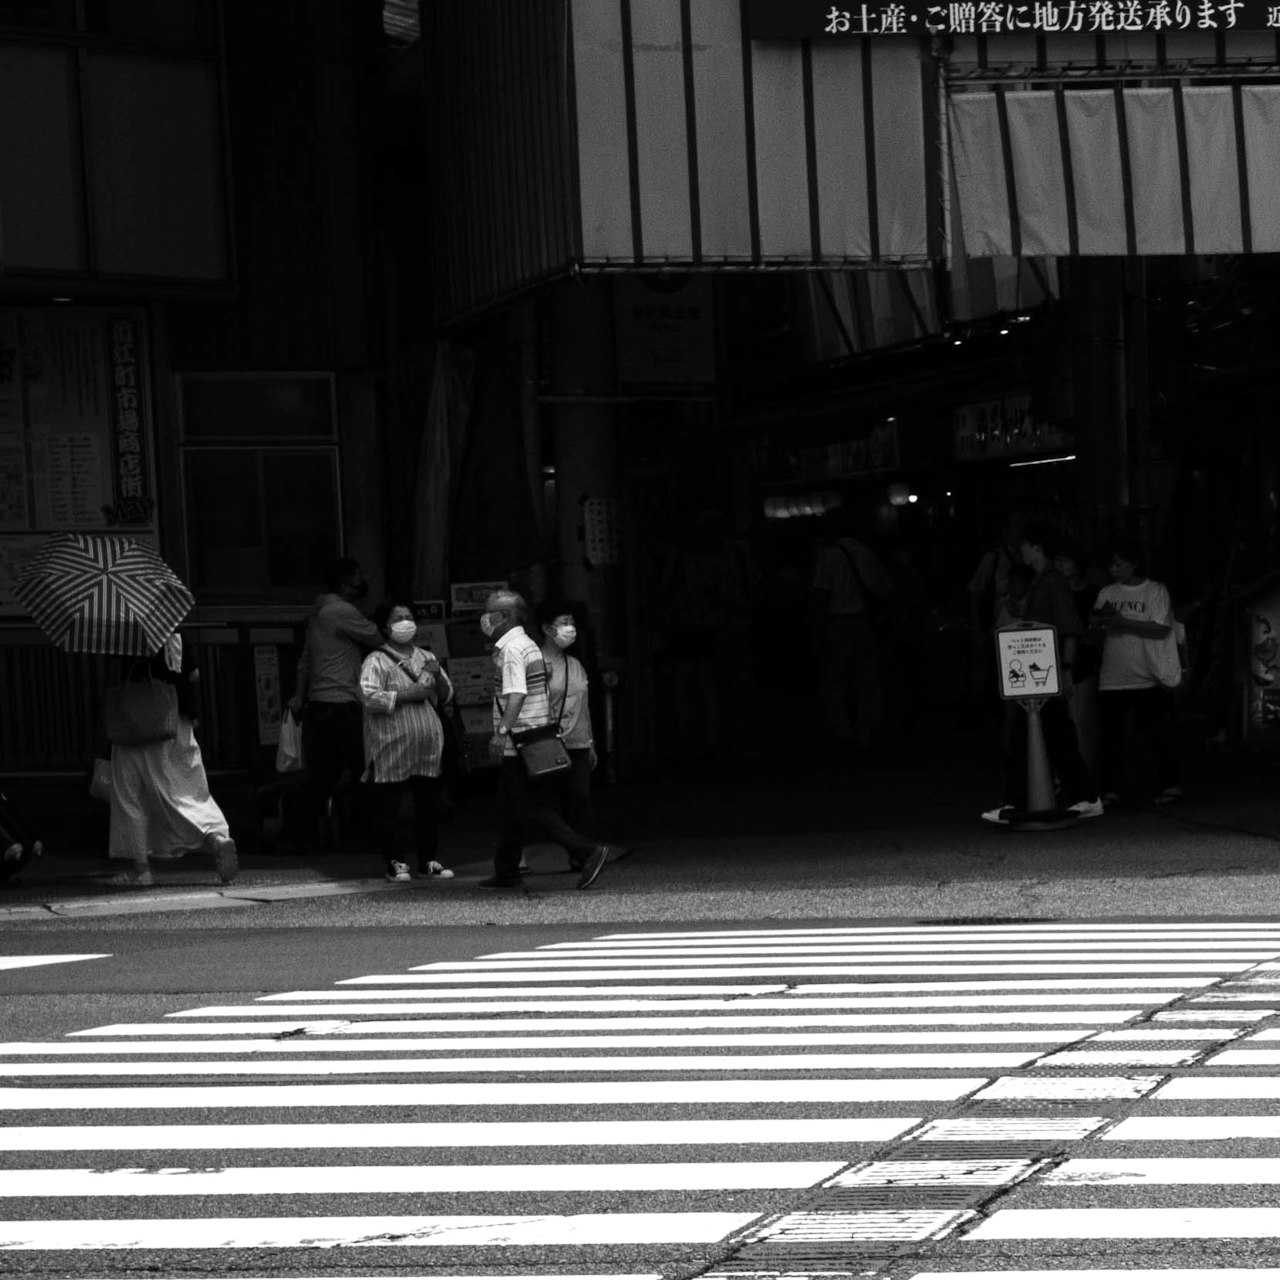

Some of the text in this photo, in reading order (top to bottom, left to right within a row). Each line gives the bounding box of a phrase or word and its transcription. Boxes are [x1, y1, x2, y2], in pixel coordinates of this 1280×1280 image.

[824, 0, 1245, 34] お土産・ご贈答に地方発送承ります
[111, 320, 143, 497] 近江町市場商店街
